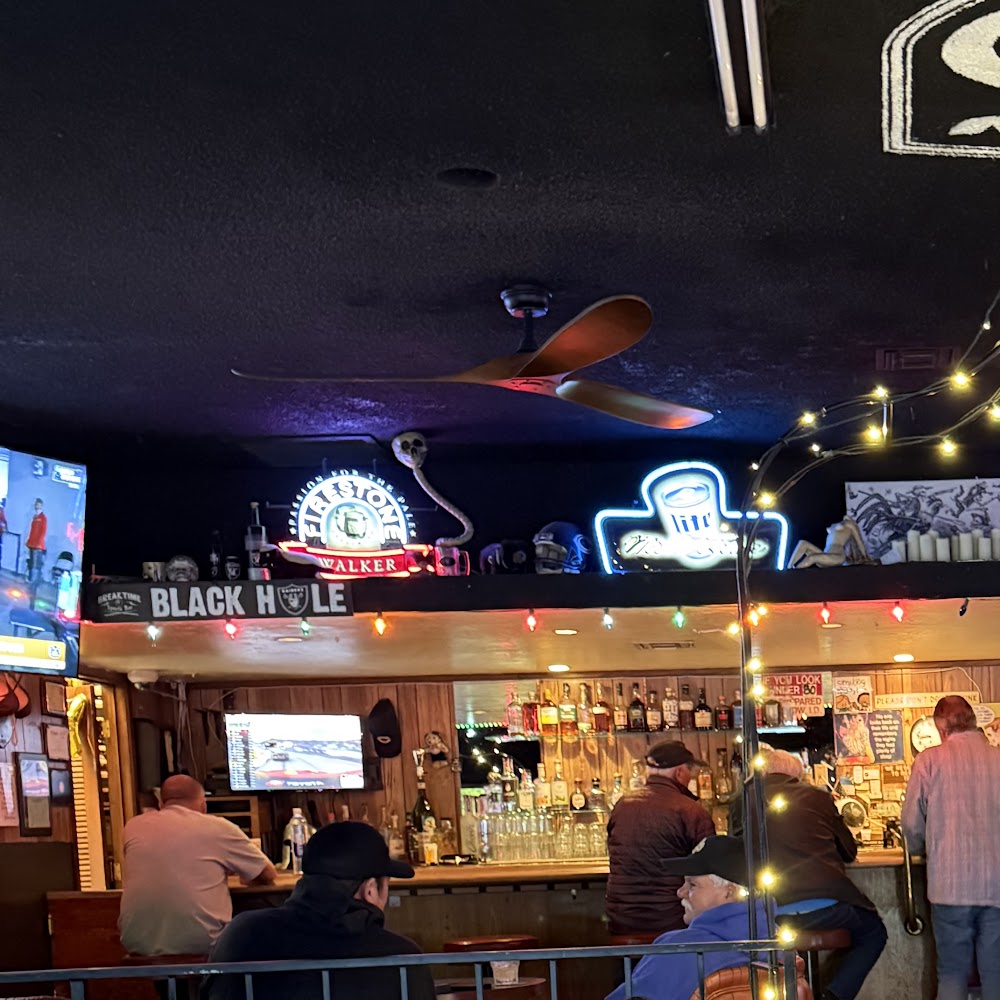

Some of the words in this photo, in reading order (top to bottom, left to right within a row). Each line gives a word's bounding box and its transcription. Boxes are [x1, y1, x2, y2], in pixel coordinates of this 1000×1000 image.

[331, 468, 360, 478] FOR
[368, 472, 395, 493] THE
[303, 479, 403, 540] FIRESTONE
[318, 557, 398, 573] WALKER
[150, 585, 246, 618] BLACK
[796, 674, 821, 685] LOOK
